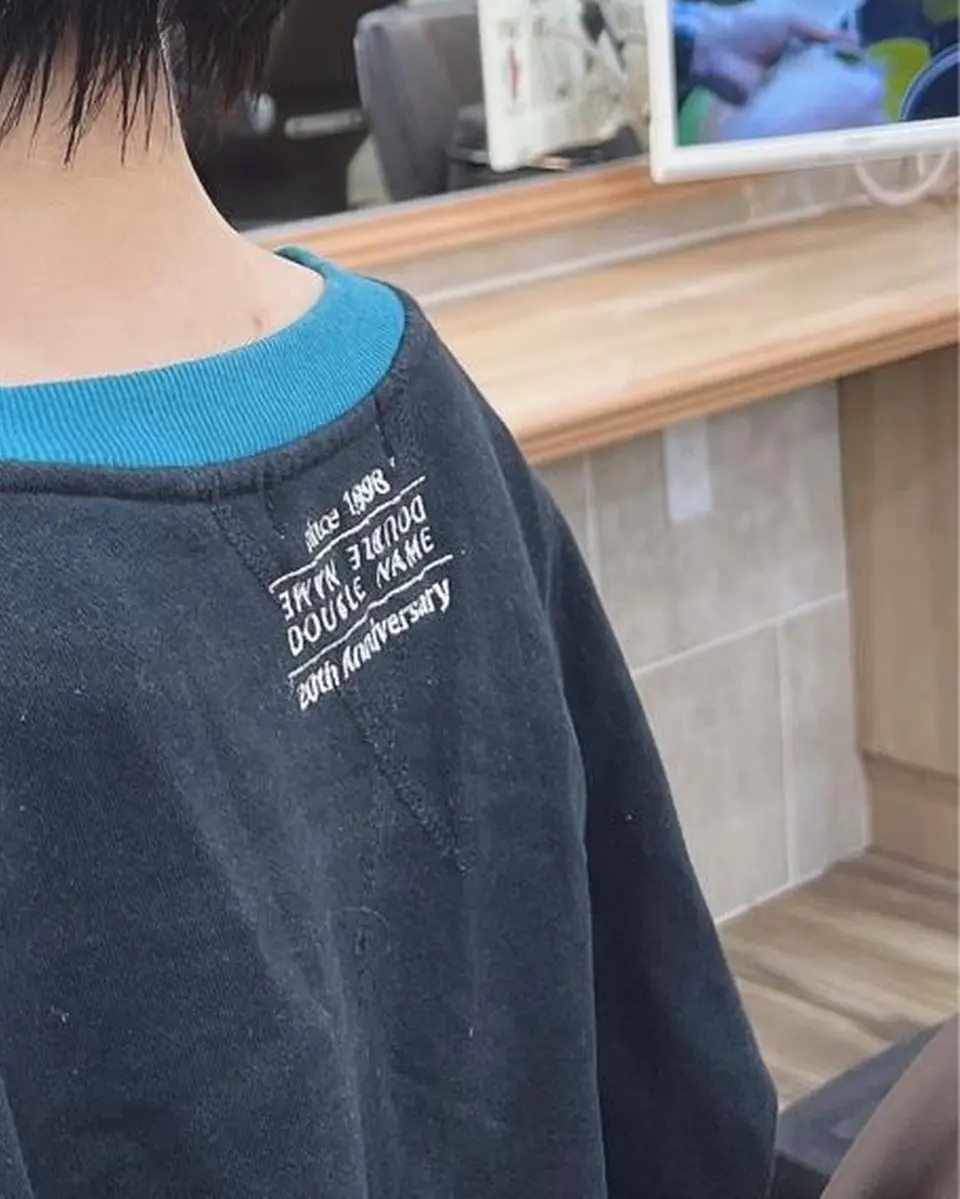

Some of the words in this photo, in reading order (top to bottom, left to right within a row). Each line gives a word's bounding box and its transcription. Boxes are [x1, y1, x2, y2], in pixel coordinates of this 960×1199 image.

[288, 576, 366, 656] DOUBLE
[376, 527, 435, 587] NAME
[342, 578, 451, 679] Anniversary
